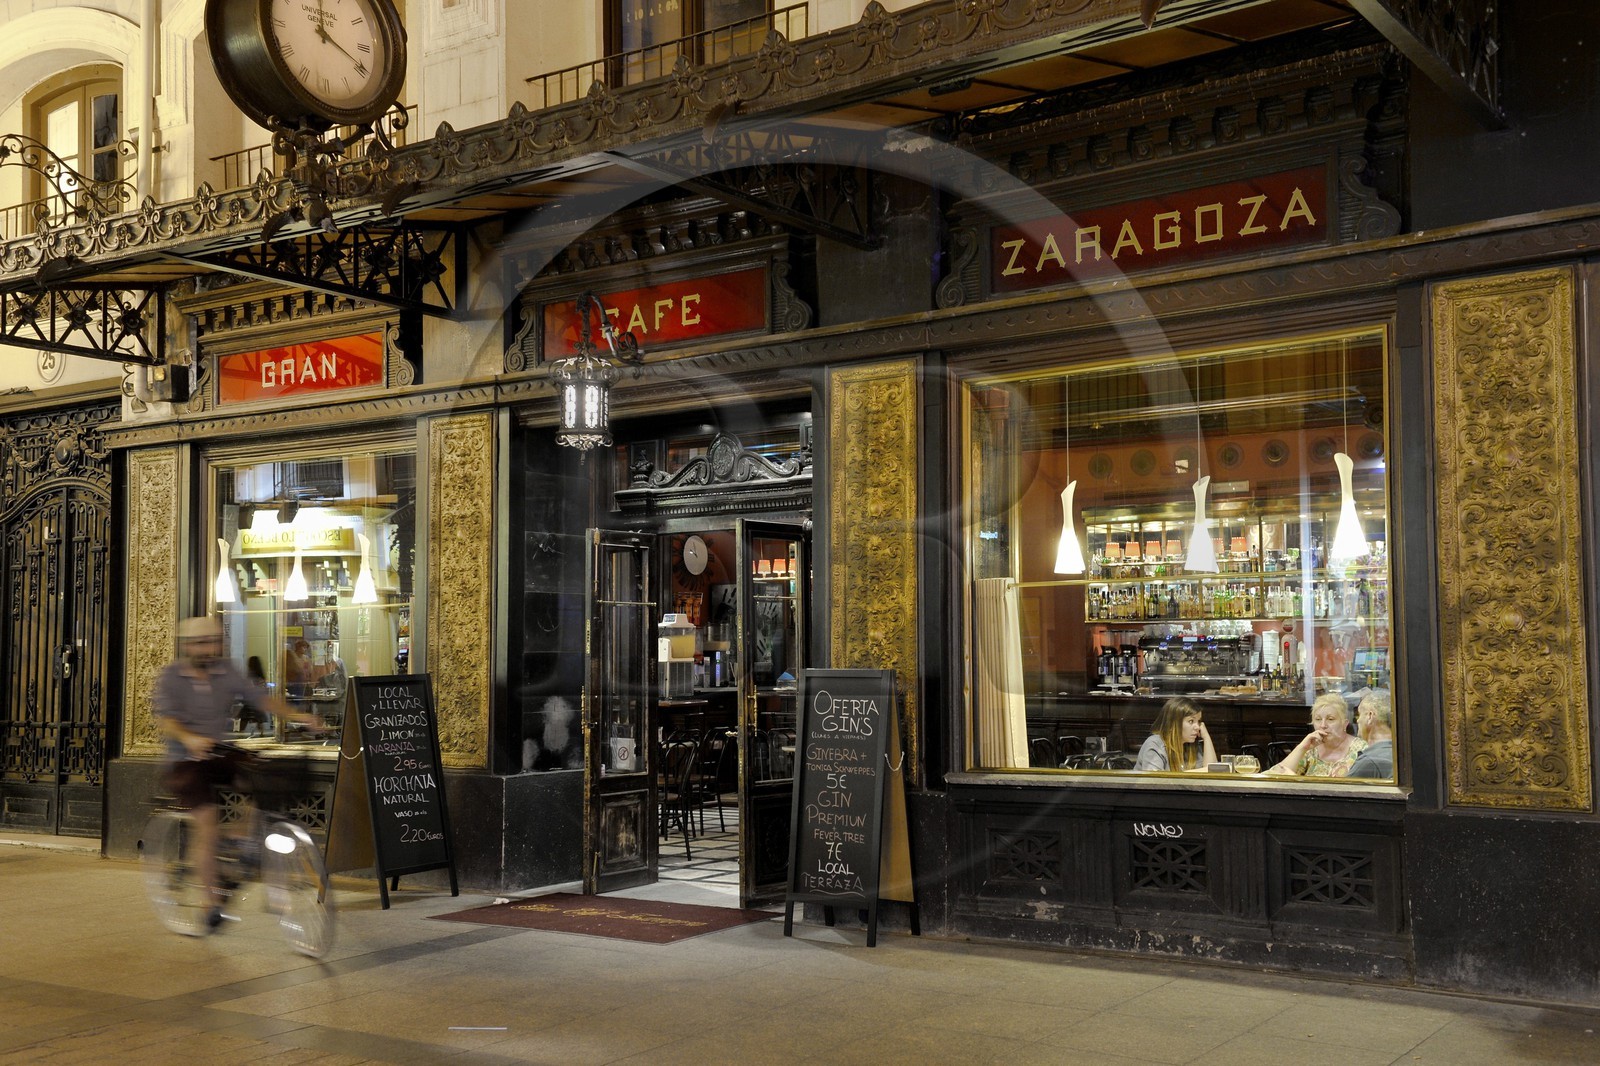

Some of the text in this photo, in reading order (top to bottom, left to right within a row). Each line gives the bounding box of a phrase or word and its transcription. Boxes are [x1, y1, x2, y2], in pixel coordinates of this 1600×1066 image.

[301, 4, 338, 21] UNIVERSAL
[1001, 186, 1317, 277] ZARAGOZA
[42, 350, 56, 370] 25
[261, 352, 337, 388] GRAN
[378, 686, 414, 699] LOCAL
[380, 697, 424, 710] LLEVAR
[814, 690, 880, 716] OFERTA
[364, 710, 428, 729] GRANIZADOS
[822, 715, 873, 736] GIN'S
[380, 729, 415, 741] LIMON
[369, 741, 415, 757] NARANJA
[806, 742, 858, 761] GINEBRA
[806, 761, 876, 776] TONICA SCHWEPPES
[374, 773, 436, 793] HORCHATA
[826, 773, 847, 789] 5€
[383, 792, 430, 805] NATURAL
[817, 790, 852, 808] GIN
[814, 828, 865, 844] FEVER TREE
[825, 841, 843, 861] 7€
[818, 859, 855, 875] LOCAL
[801, 871, 864, 891] TERRAZA
